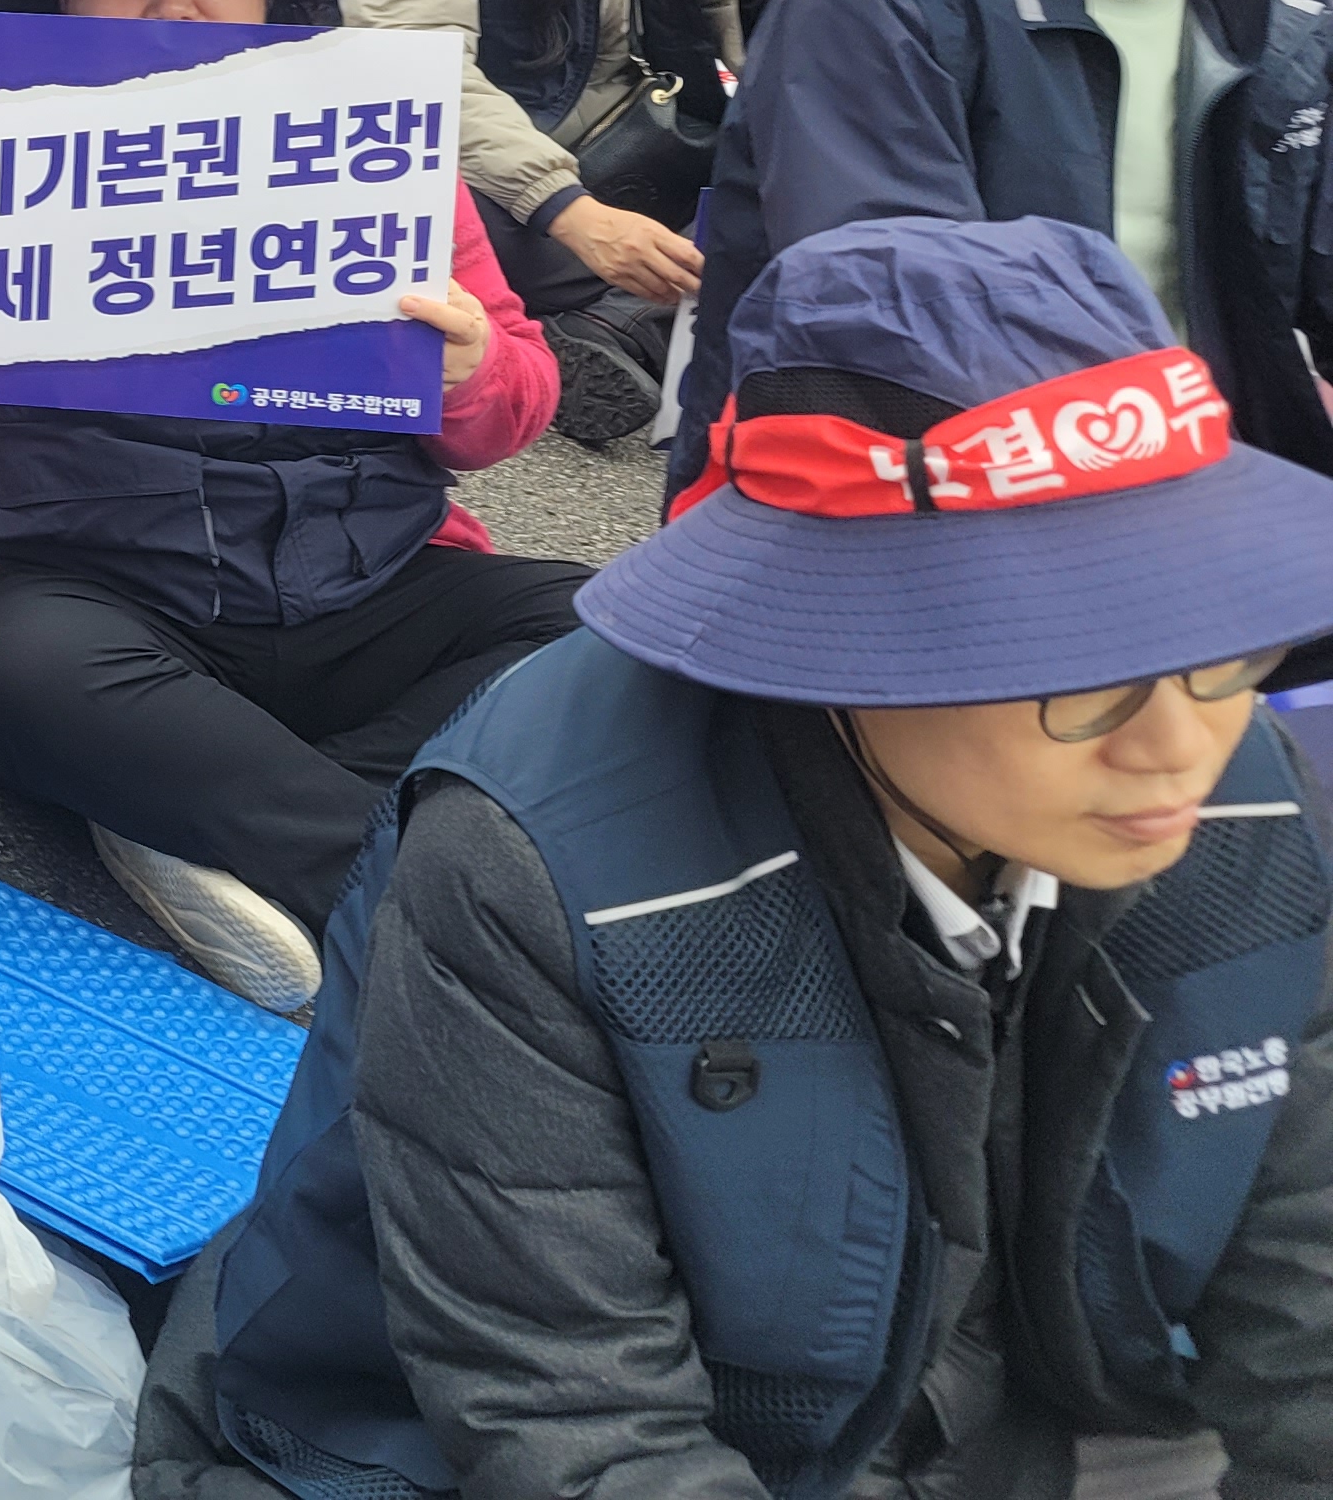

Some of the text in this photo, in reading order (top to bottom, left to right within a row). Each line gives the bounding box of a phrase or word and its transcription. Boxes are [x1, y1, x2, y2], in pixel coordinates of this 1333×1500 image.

[267, 98, 444, 191] 보장!
[87, 214, 434, 318] 정년연장!
[249, 386, 423, 419] 공무원노동조합연맹
